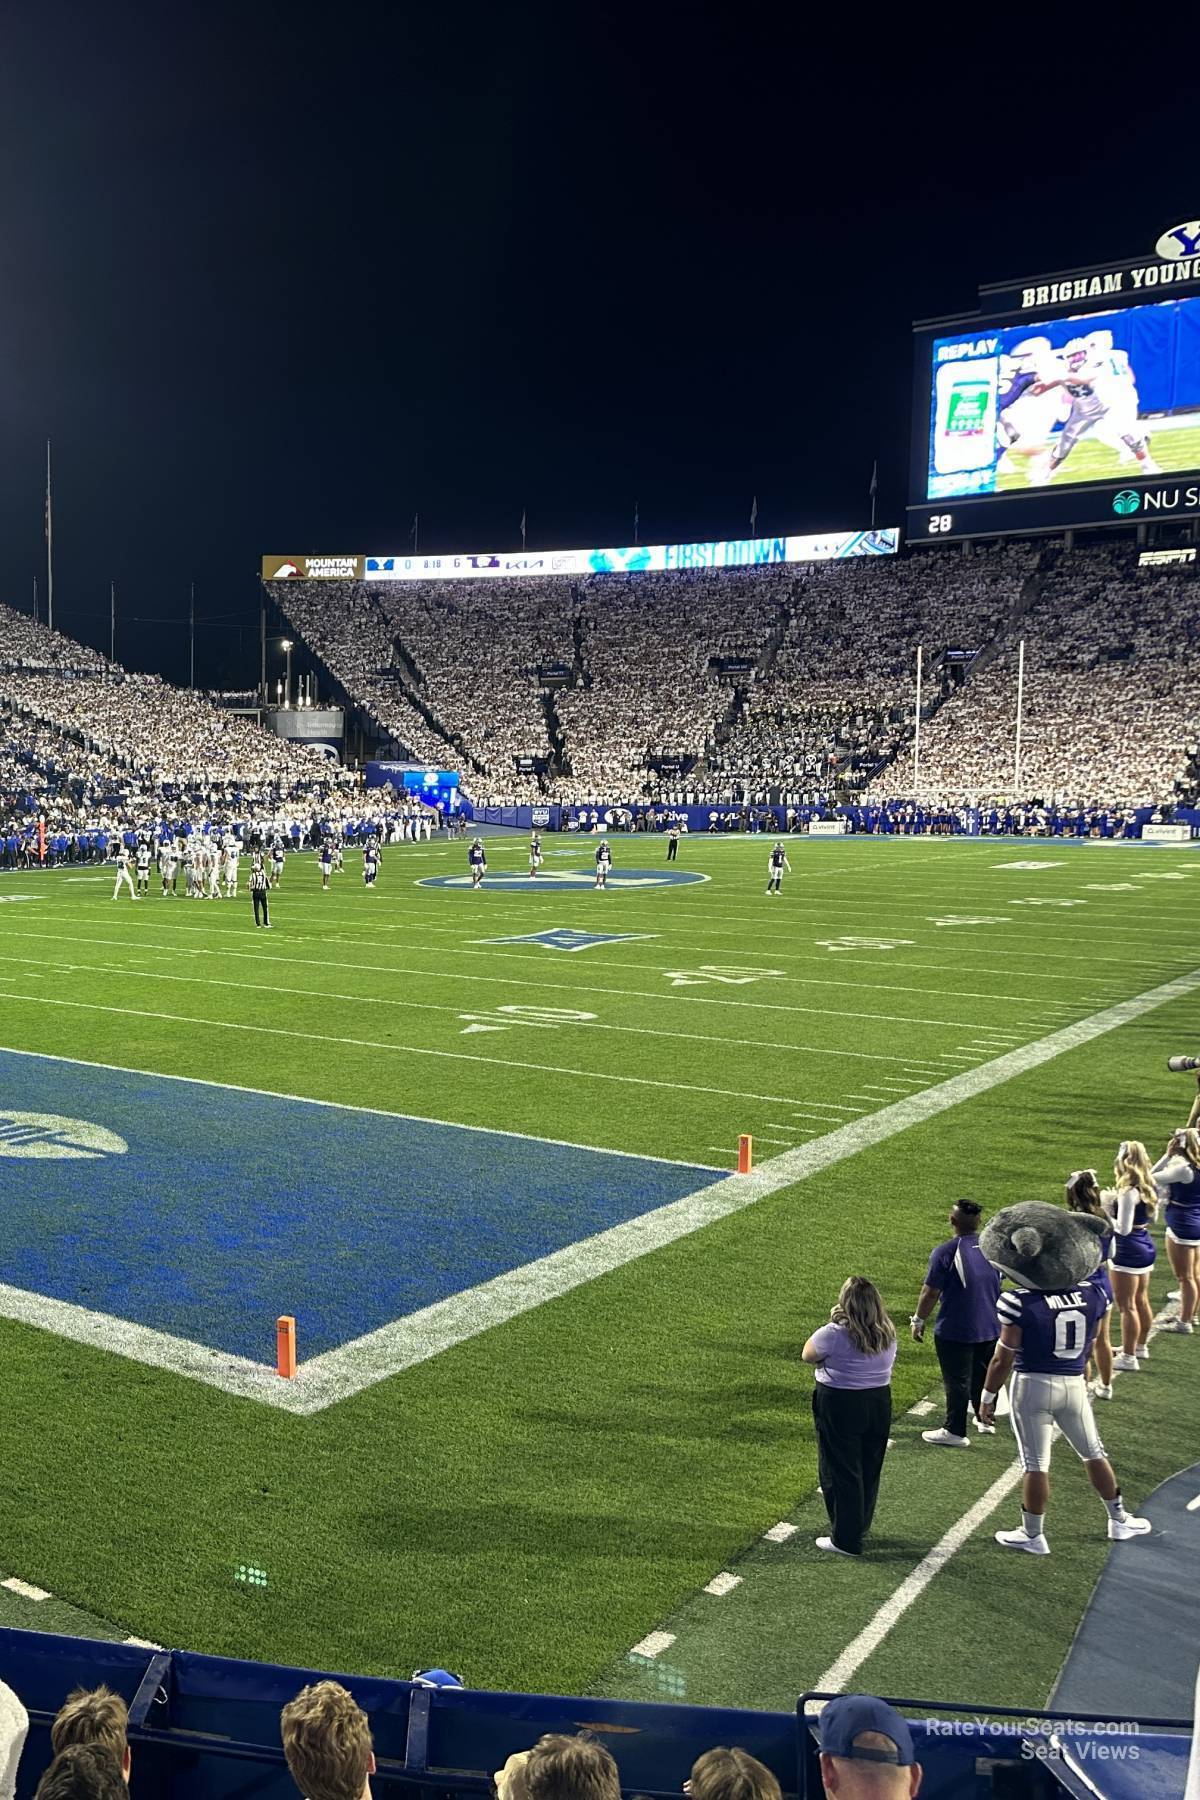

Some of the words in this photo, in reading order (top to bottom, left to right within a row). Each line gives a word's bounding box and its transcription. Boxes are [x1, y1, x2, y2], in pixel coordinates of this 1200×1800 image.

[1021, 271, 1123, 308] BRIGHAM
[937, 338, 999, 362] REPLAY
[1143, 489, 1179, 510] NU
[1184, 487, 1200, 507] S
[928, 514, 952, 534] 28
[305, 558, 357, 568] MOUNTAIN
[1138, 548, 1197, 567] ESPN
[308, 567, 355, 577] AMERICA
[662, 965, 786, 985] 20
[458, 1005, 599, 1029] 10
[1043, 1291, 1087, 1309] WILLIE
[1052, 1309, 1086, 1359] 0
